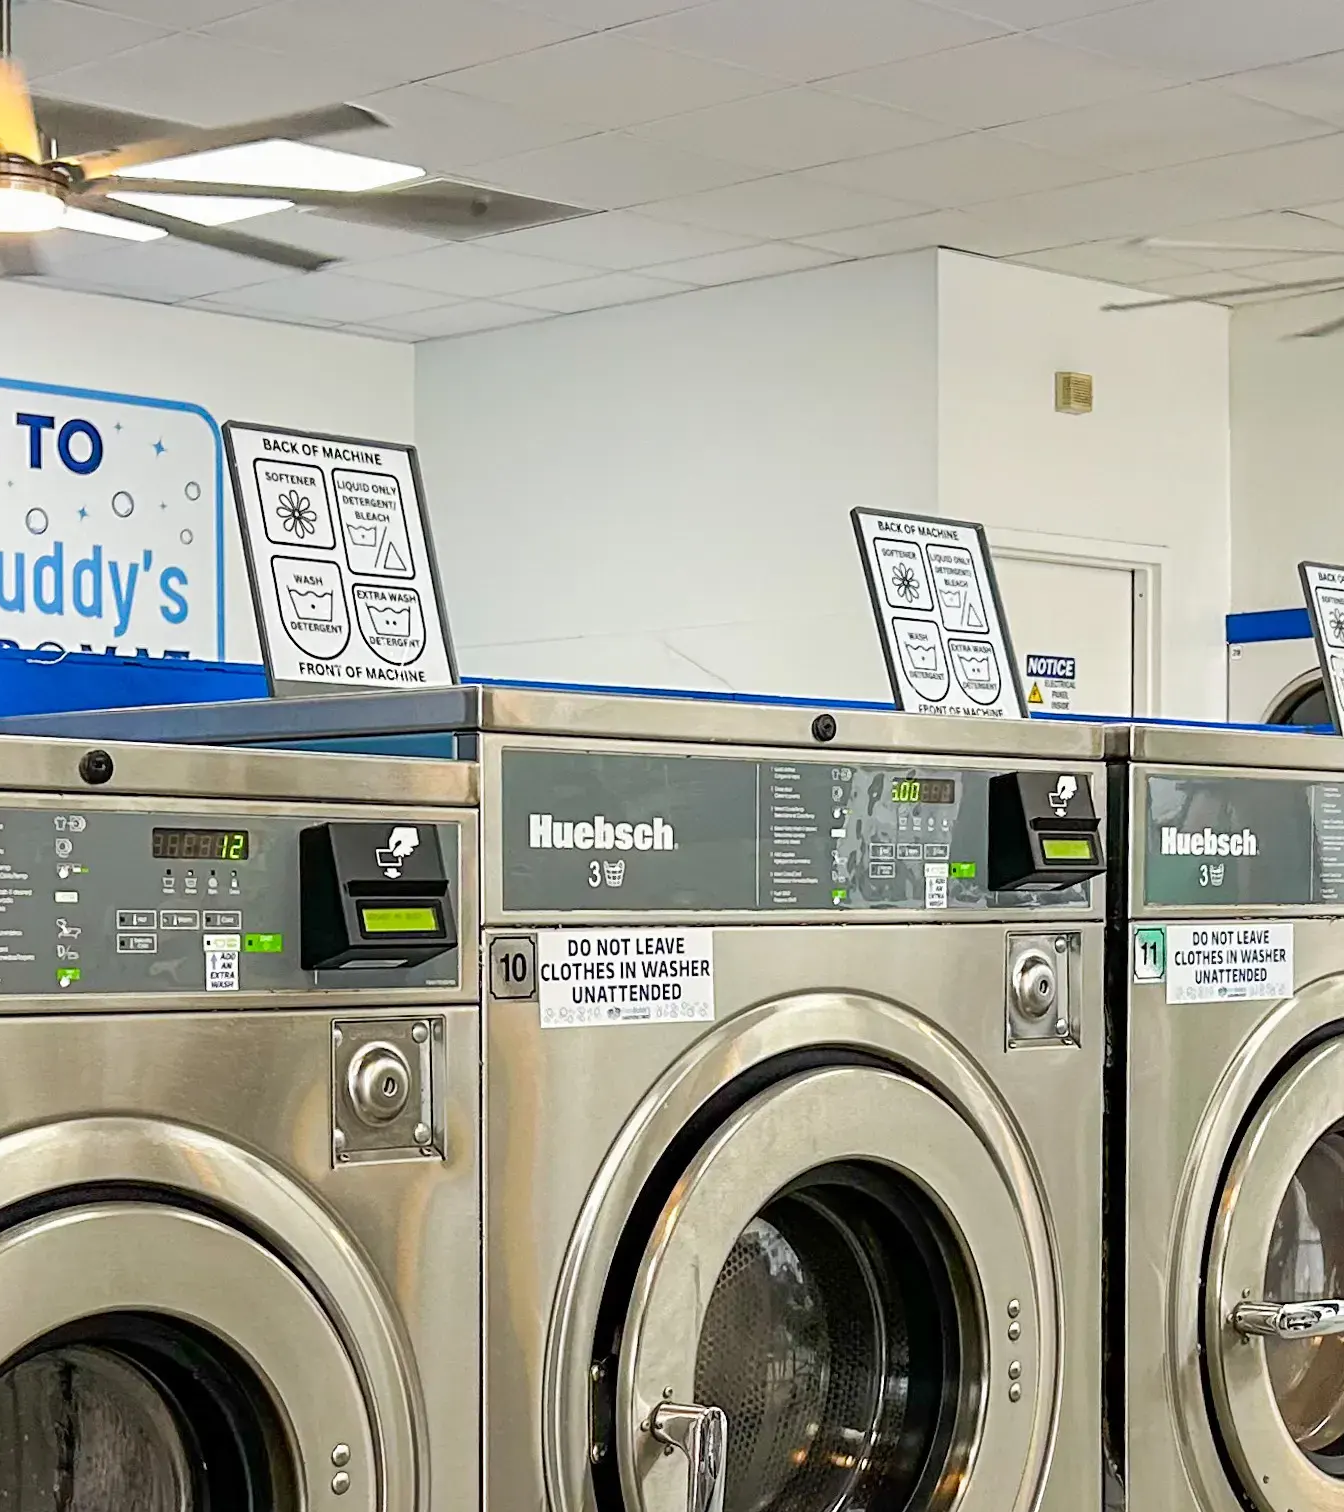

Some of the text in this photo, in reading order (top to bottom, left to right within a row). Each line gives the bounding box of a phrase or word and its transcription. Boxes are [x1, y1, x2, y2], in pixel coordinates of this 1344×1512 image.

[16, 413, 103, 476] TO
[263, 439, 382, 466] BACK OF MACHINE
[265, 471, 316, 487] SOFTENER
[337, 480, 396, 495] LIQUID ONLY
[355, 511, 390, 523] BLEACH
[878, 520, 959, 541] BACK OF MACHINE
[293, 574, 323, 586] WASH
[357, 590, 416, 603] EXTRA WASH
[290, 621, 342, 634] DETERGENT
[369, 636, 420, 648] DETERGENT
[299, 662, 426, 682] FRONT OF MACHINE
[1027, 658, 1074, 676] NOTICE
[529, 814, 674, 850] Huebsch
[1162, 827, 1256, 856] Huebsch
[222, 835, 243, 858] 12
[588, 861, 601, 887] 3
[1199, 866, 1208, 886] 3
[568, 937, 685, 956] DO NOT LEAVE
[1192, 930, 1270, 946] DO NOT LEAVE
[1141, 943, 1157, 965] 11
[1175, 948, 1286, 966] CLOTHES IN WASHER
[500, 953, 526, 982] 10
[541, 960, 710, 981] CLOTHES IN WASHER
[1195, 969, 1267, 984] UNATTENDED
[573, 984, 682, 1003] UNATTENDED
